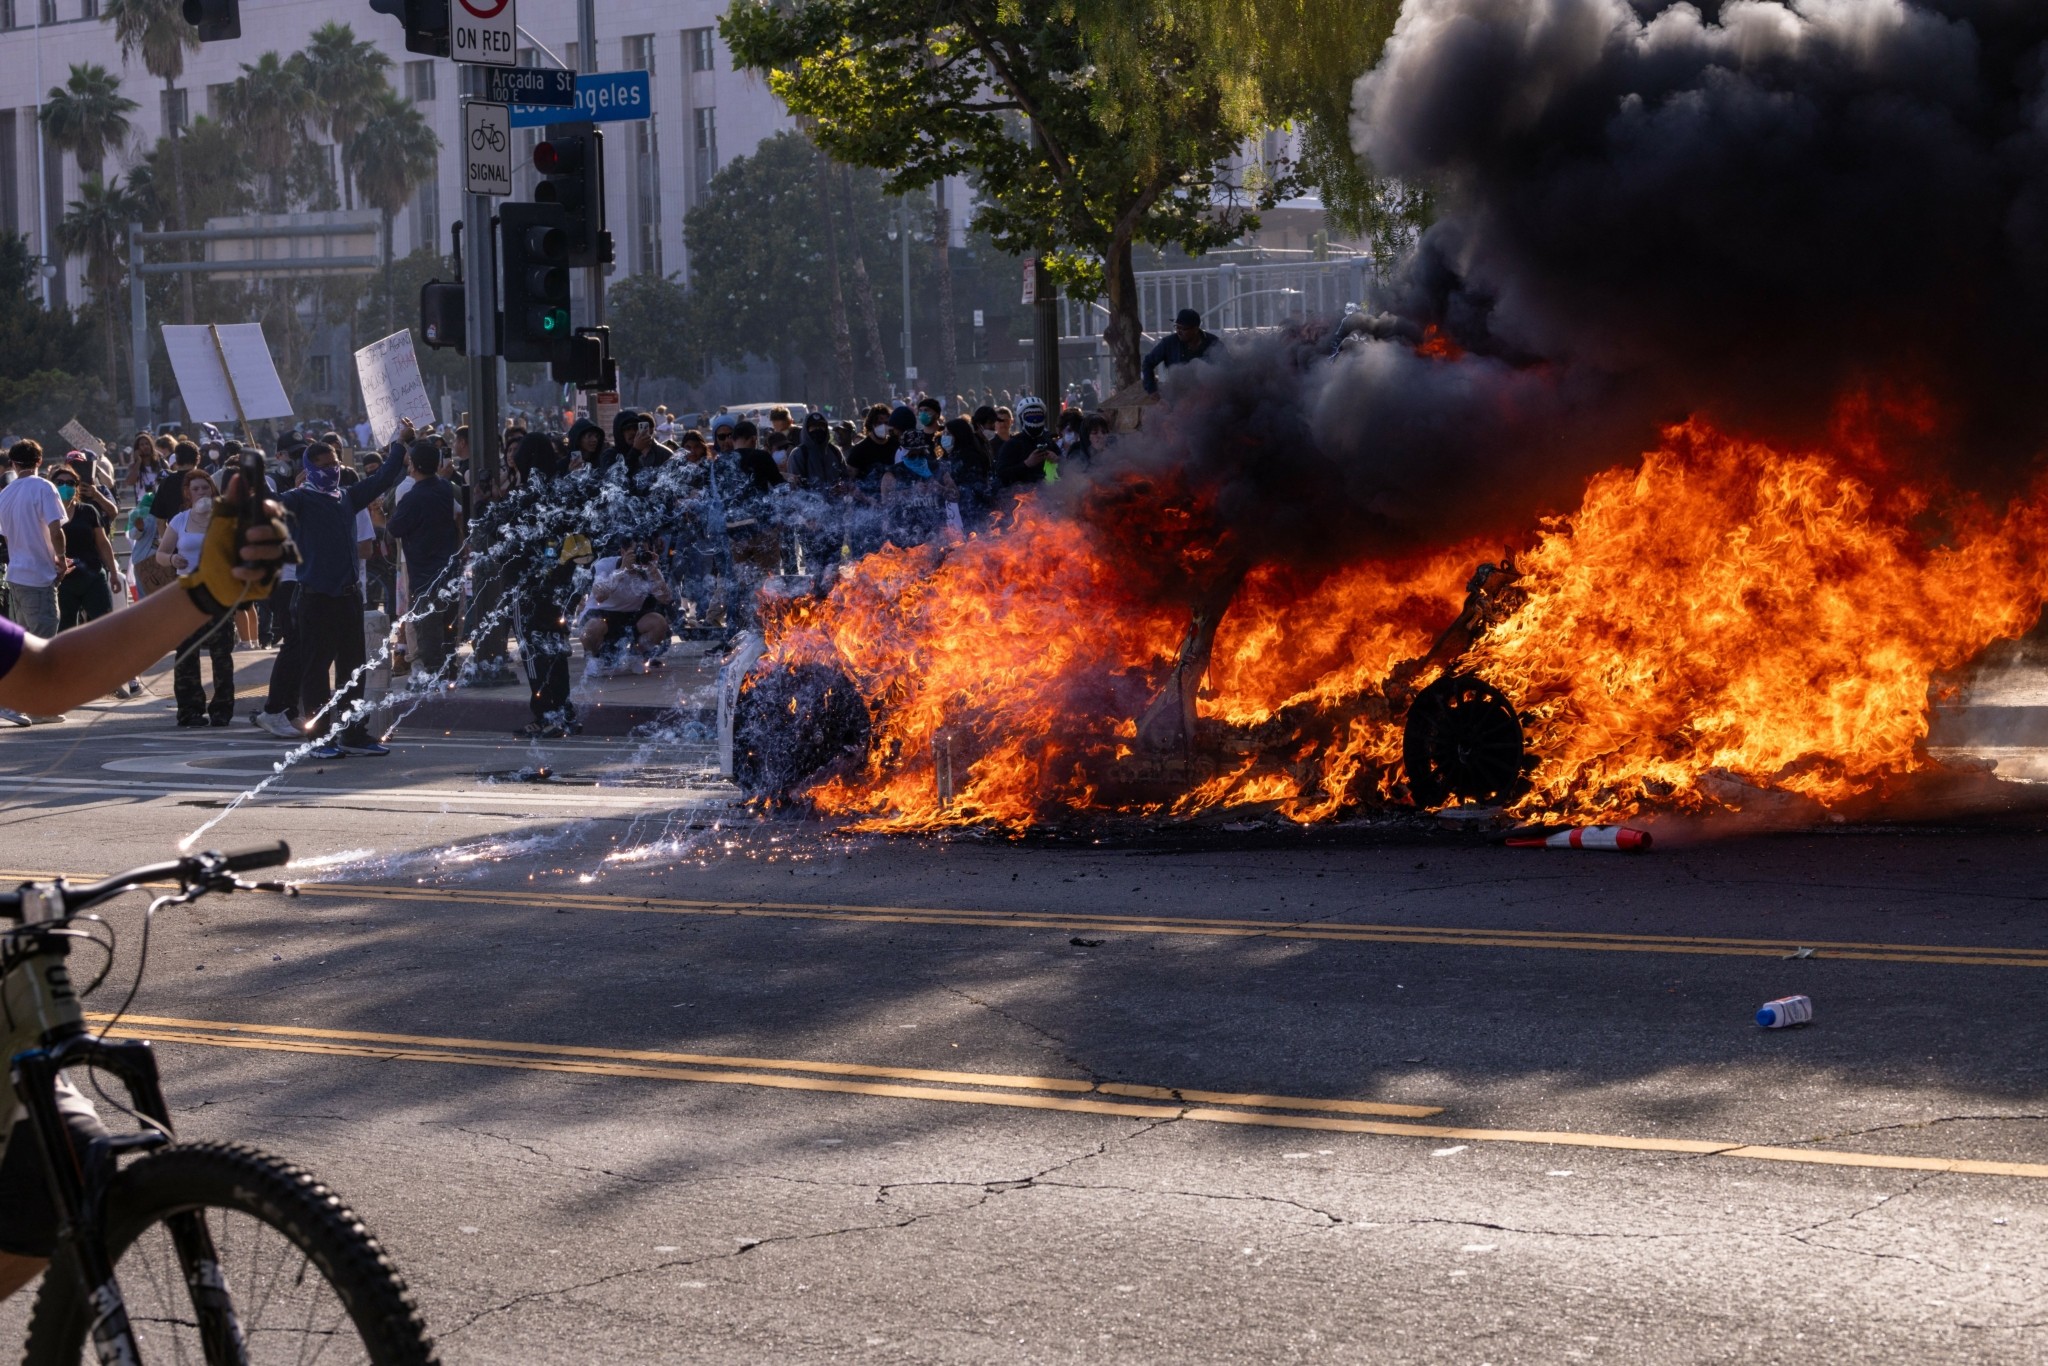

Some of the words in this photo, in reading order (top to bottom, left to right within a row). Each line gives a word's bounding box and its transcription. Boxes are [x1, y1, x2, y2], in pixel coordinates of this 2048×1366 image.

[457, 27, 477, 49] ON
[483, 32, 511, 52] RED
[492, 69, 544, 90] Arcadia
[556, 72, 571, 91] St
[493, 89, 508, 101] 100
[513, 89, 519, 101] E
[573, 83, 641, 116] ngeles
[470, 163, 508, 182] SIGNAL
